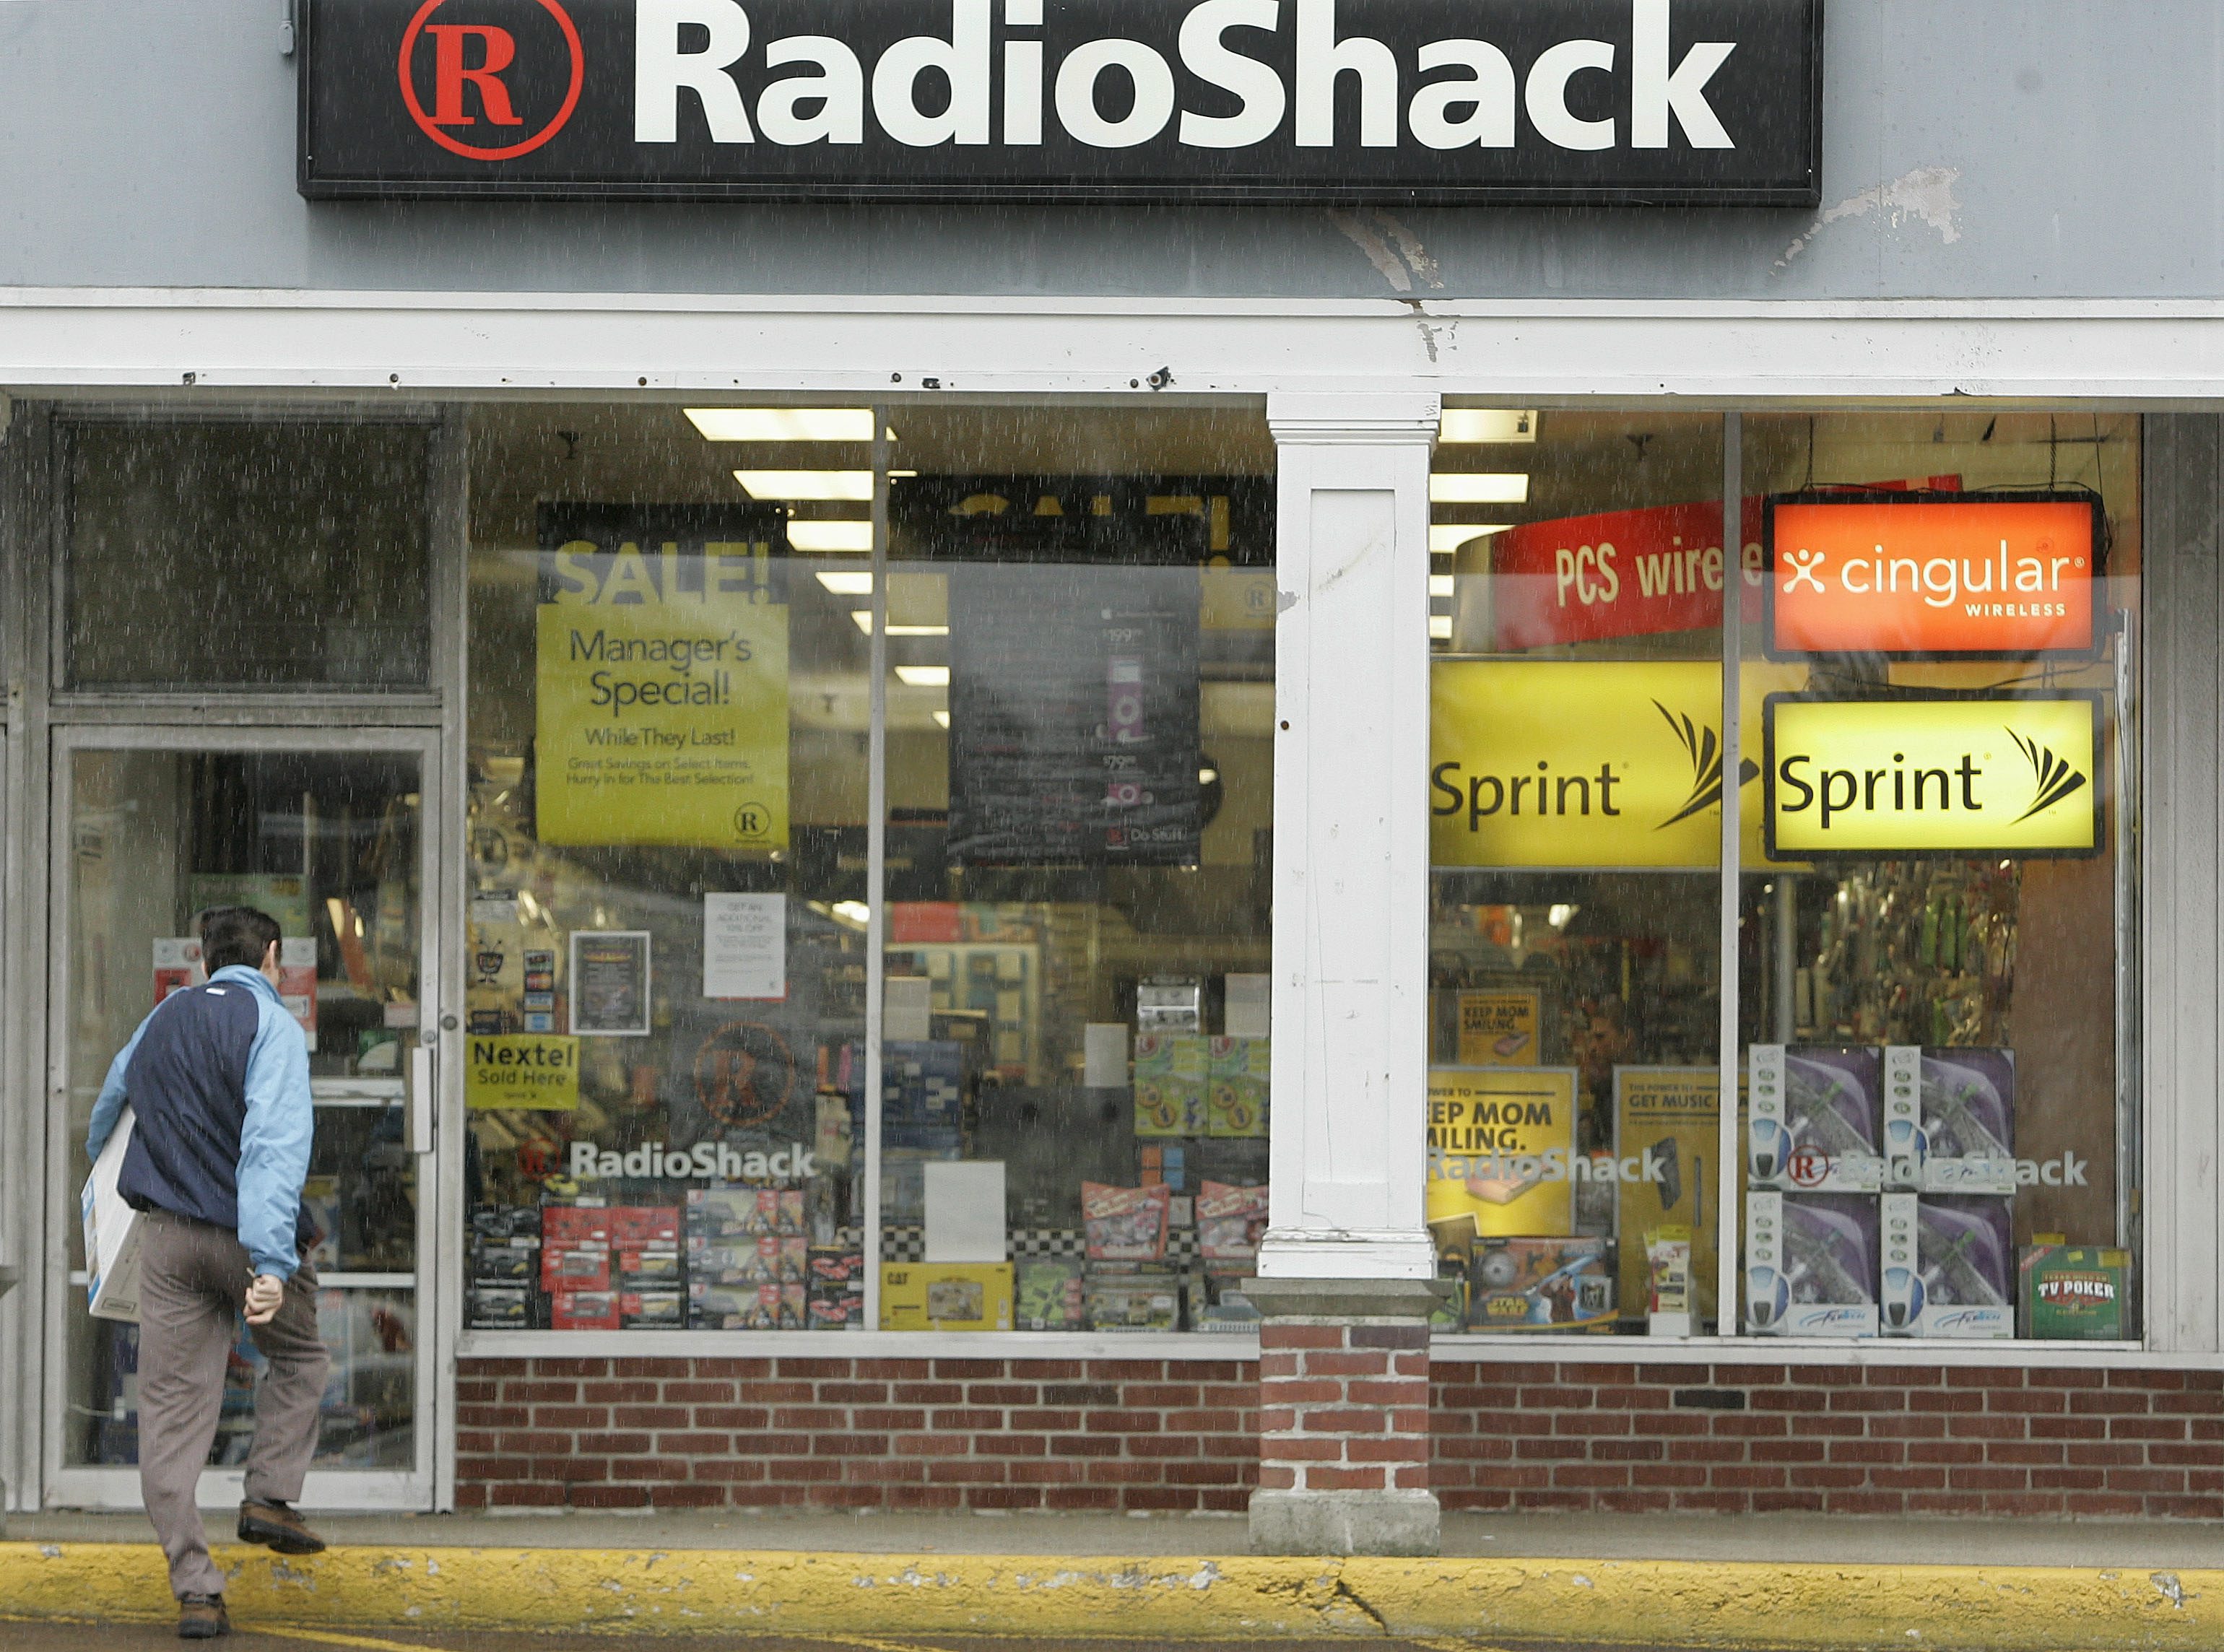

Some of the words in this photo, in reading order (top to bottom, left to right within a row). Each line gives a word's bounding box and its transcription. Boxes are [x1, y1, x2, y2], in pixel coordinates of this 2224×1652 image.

[635, 0, 1736, 150] RadioShack
[553, 540, 770, 605] SALE!
[1555, 542, 1620, 607] PCS
[1841, 539, 2070, 607] cingular
[1965, 603, 2067, 617] WIRELESS
[570, 629, 752, 671] Manager's
[590, 669, 730, 717] Special!
[585, 728, 638, 746] While
[640, 728, 686, 750] They
[690, 728, 735, 746] Last!
[1431, 760, 1621, 832] Sprint
[1779, 753, 1983, 830] Sprint
[474, 1042, 573, 1066] Nextel
[478, 1069, 516, 1084] Sold
[524, 1069, 567, 1086] Here
[1472, 1102, 1552, 1126] MOM
[1629, 1094, 1658, 1108] GET
[1662, 1094, 1713, 1108] MUSIC
[570, 1141, 817, 1180] RadioShack
[2038, 1282, 2059, 1298] TV
[2063, 1280, 2116, 1299] POKER
